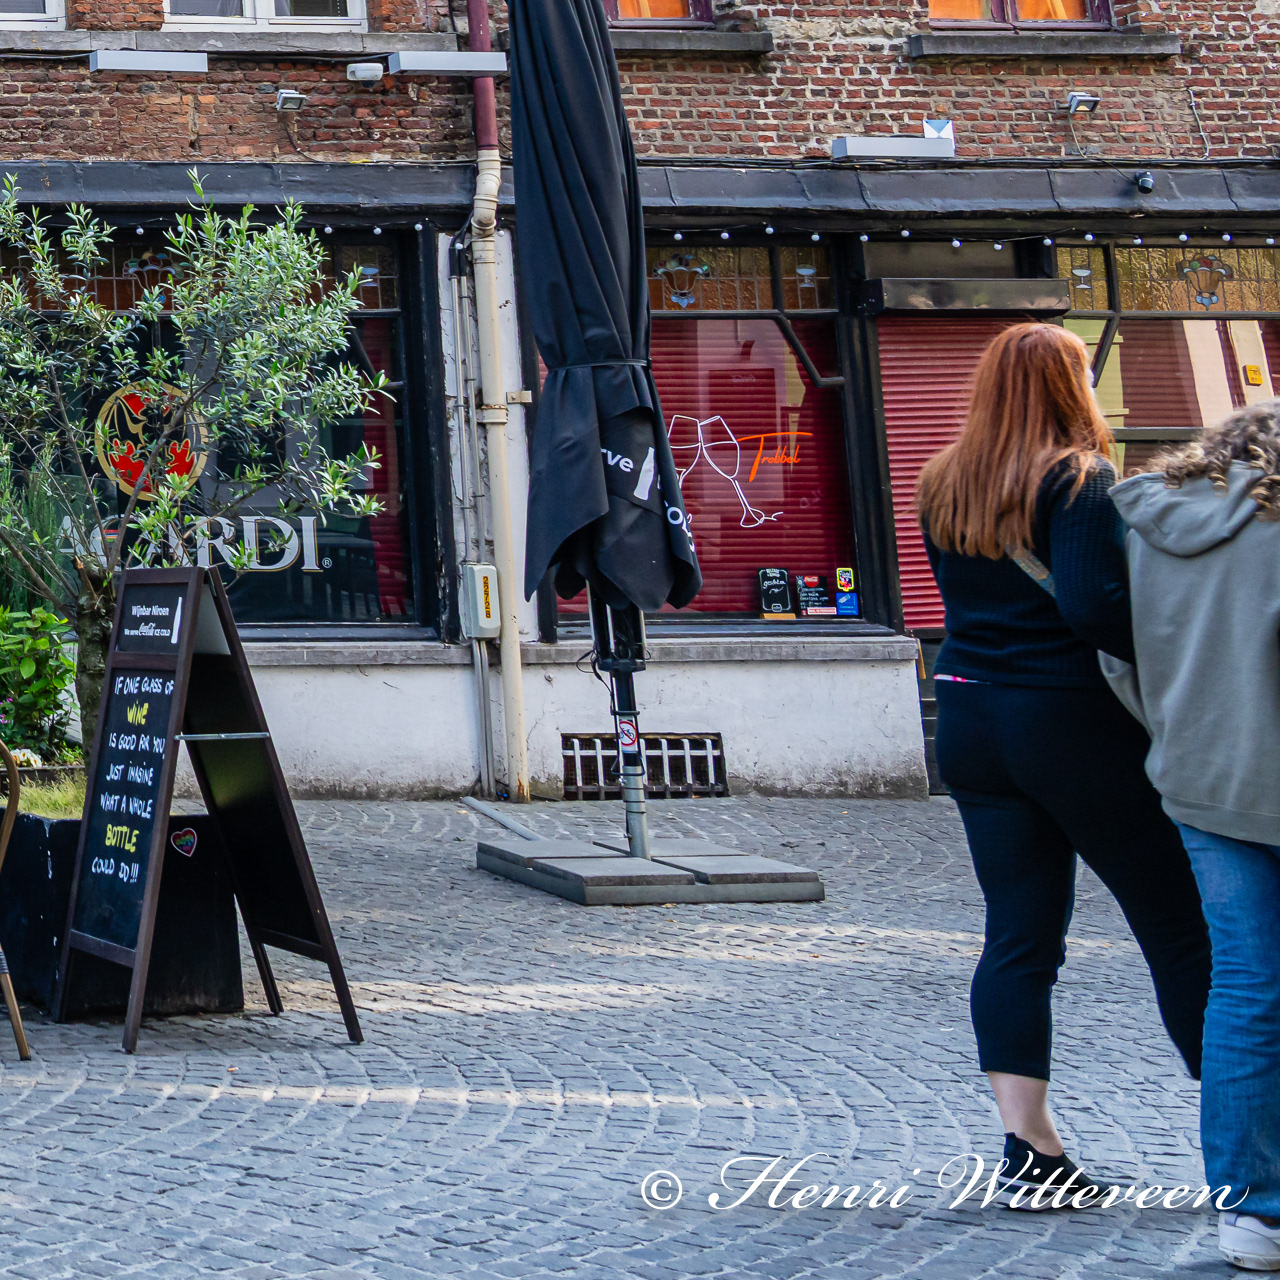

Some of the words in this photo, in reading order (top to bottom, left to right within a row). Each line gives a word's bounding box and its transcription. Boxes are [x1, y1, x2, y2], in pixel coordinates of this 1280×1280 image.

[131, 605, 151, 618] Wijnbar
[151, 605, 169, 616] Niroen
[115, 676, 124, 695] IF
[123, 676, 141, 695] ONE
[141, 676, 163, 694] GLASS
[165, 679, 175, 695] OF
[109, 732, 117, 748] IS
[118, 733, 137, 750] GOOD
[138, 733, 150, 751] FOR
[105, 763, 125, 781] JUST
[100, 792, 120, 812] WHAT
[120, 794, 126, 813] A
[105, 823, 139, 853] BOTTLE
[92, 856, 116, 875] COULD
